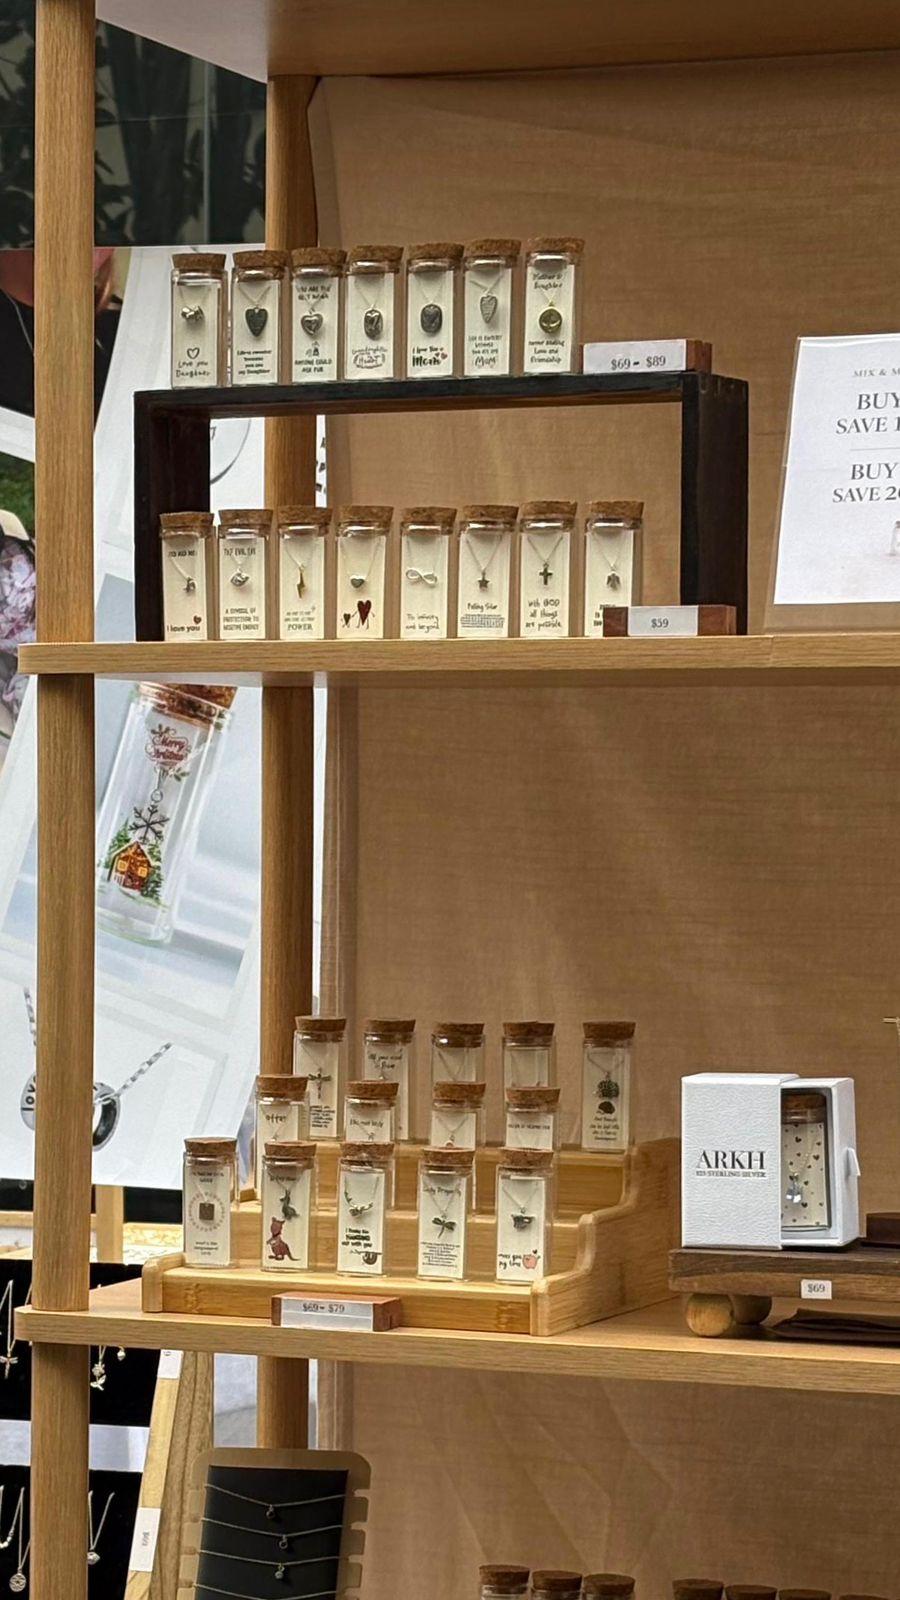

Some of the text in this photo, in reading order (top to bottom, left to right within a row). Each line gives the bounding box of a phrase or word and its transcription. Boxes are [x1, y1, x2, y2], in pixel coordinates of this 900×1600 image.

[611, 359, 630, 370] $69
[646, 356, 666, 367] $89
[852, 369, 876, 378] MIX
[879, 368, 887, 376] &
[857, 391, 900, 410] BUY
[836, 416, 889, 434] SAVE
[851, 462, 899, 480] BUY
[832, 485, 900, 503] SAVE 2
[186, 625, 201, 633] you
[651, 618, 669, 629] $59
[696, 1150, 766, 1170] ARKH
[807, 1283, 825, 1293] $69
[302, 1303, 318, 1312] $69
[327, 1304, 345, 1313] $79
